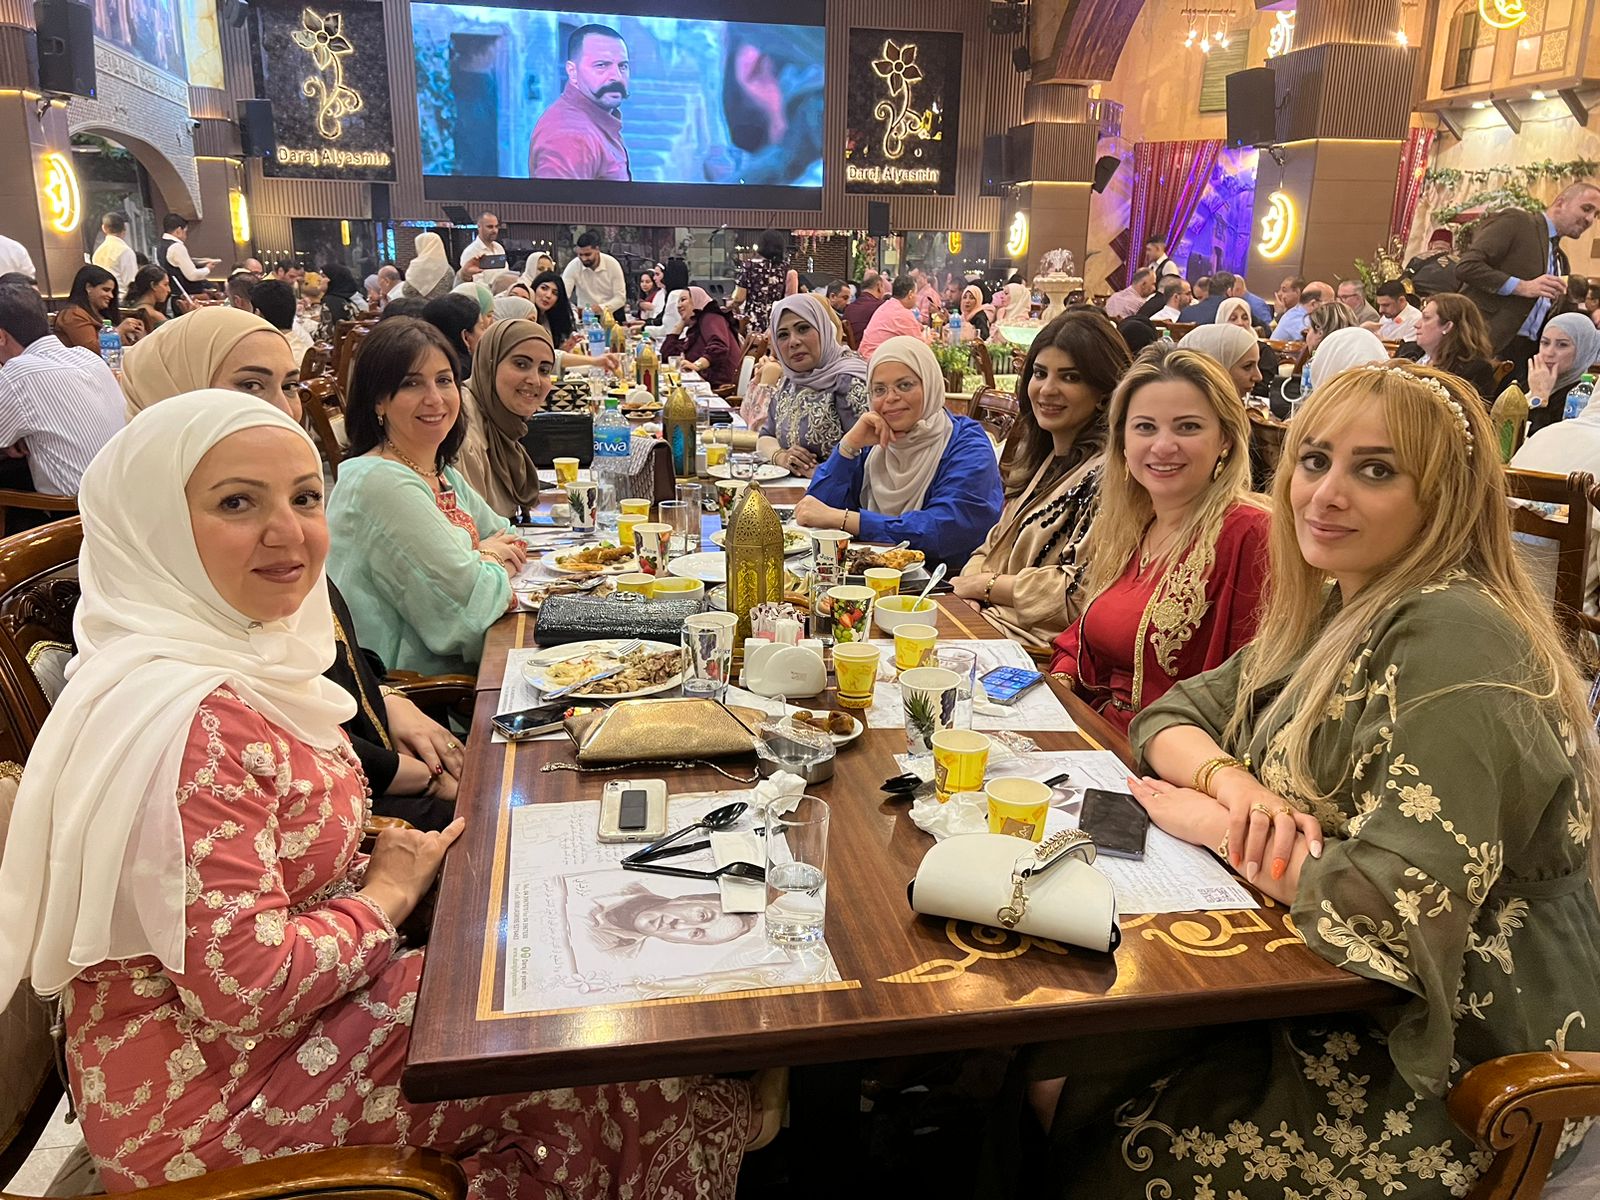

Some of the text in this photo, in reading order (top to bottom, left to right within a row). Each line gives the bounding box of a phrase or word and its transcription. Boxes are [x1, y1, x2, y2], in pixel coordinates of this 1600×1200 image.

[278, 146, 390, 167] Daraj Alyasmin
[847, 165, 940, 184] Daraj Alyasmin
